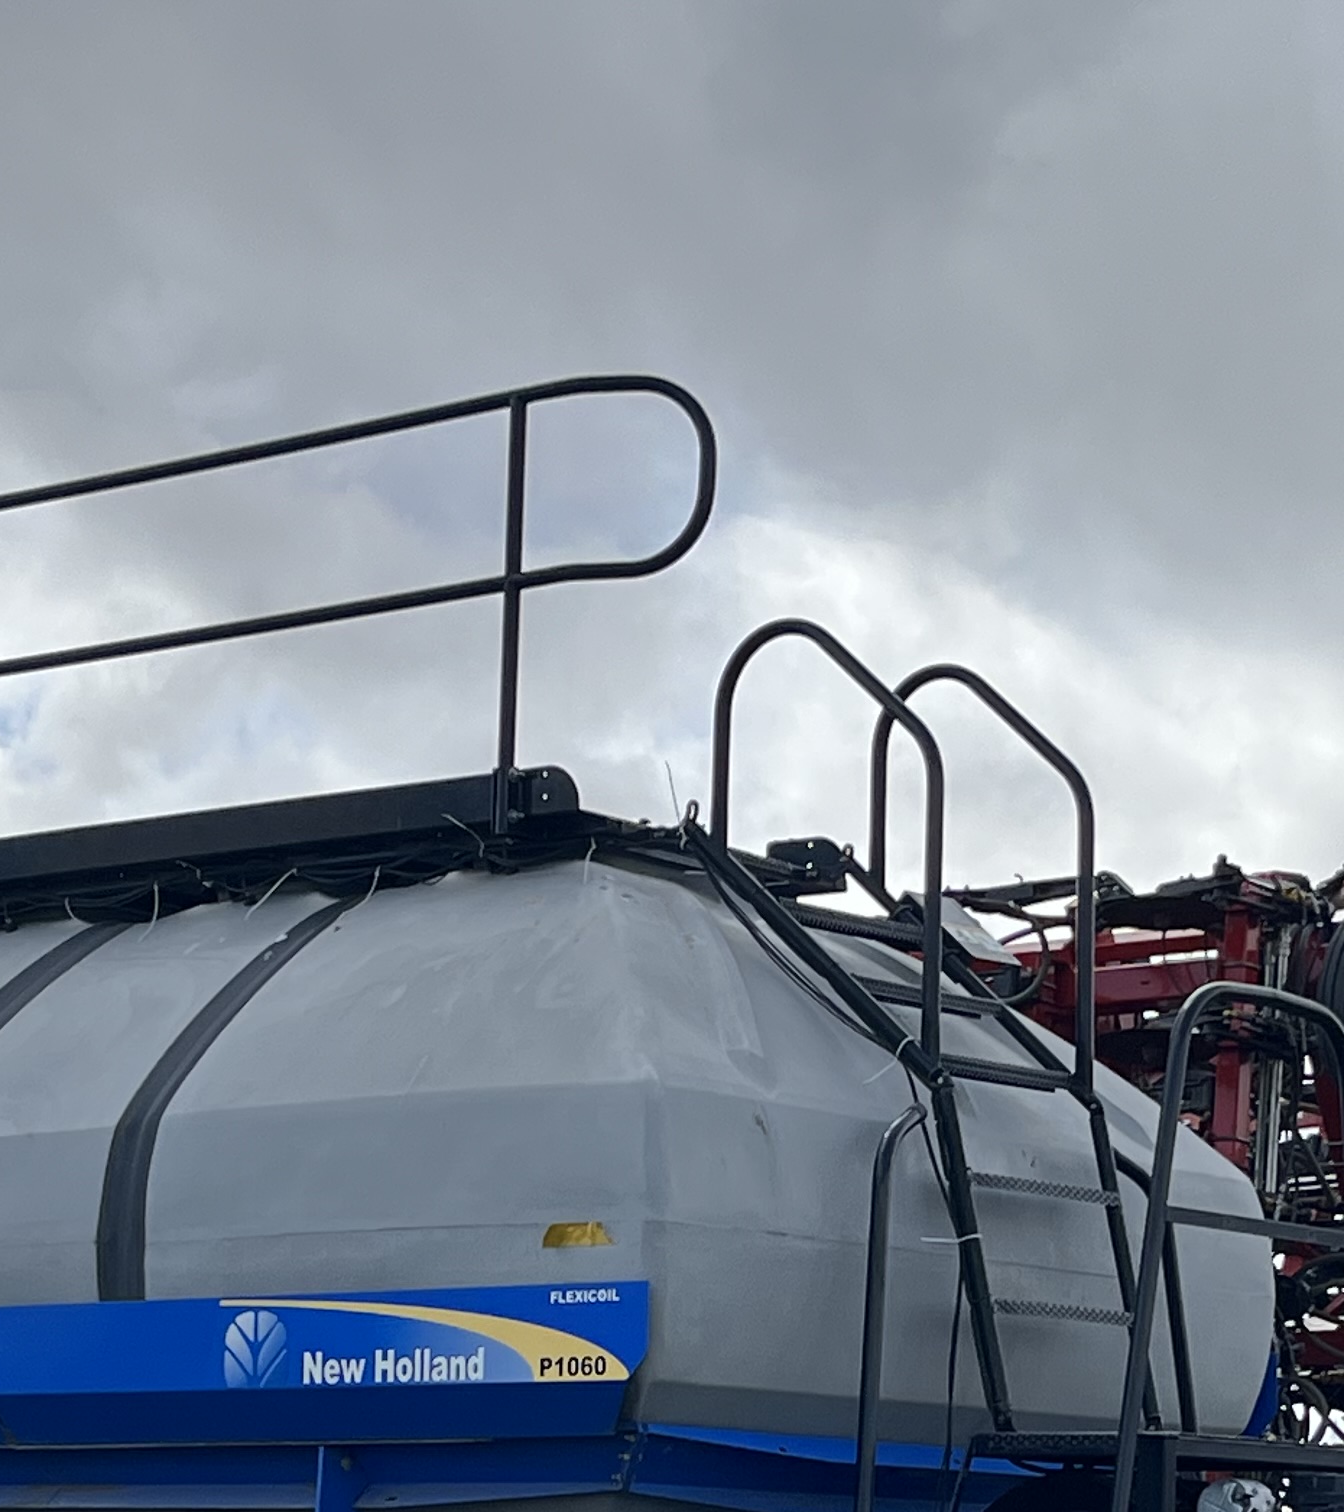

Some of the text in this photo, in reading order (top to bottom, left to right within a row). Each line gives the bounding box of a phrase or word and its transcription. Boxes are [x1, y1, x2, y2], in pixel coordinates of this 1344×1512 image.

[550, 1288, 620, 1304] FLEXICOIL
[303, 1346, 484, 1384] New Holland
[539, 1355, 607, 1377] P1060
